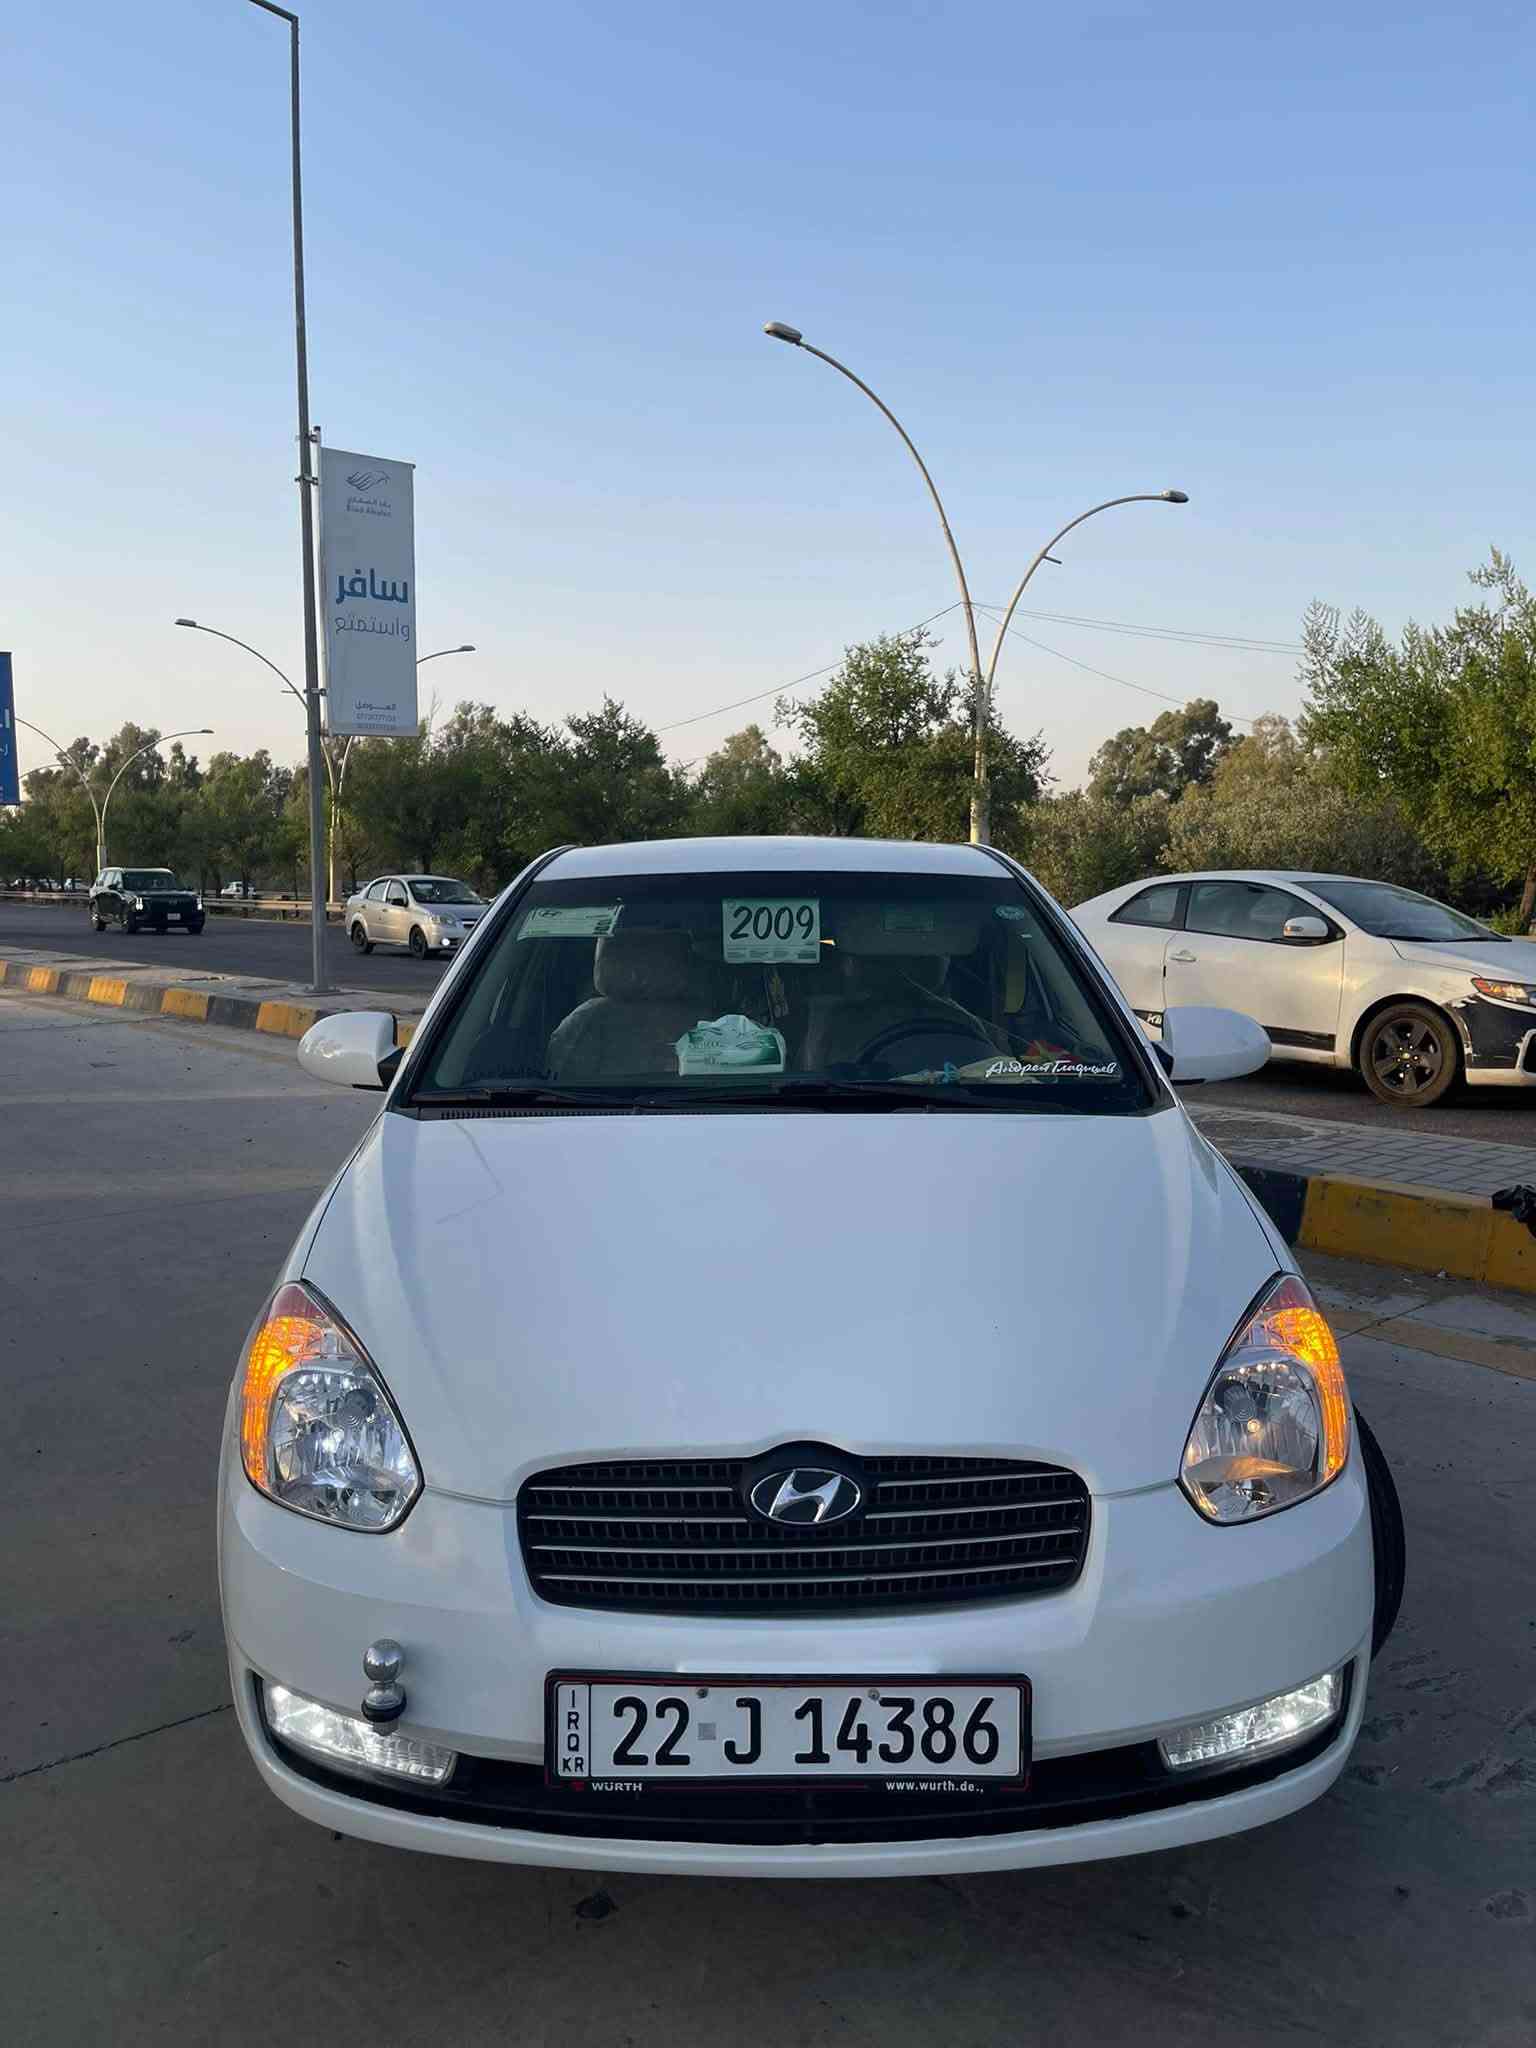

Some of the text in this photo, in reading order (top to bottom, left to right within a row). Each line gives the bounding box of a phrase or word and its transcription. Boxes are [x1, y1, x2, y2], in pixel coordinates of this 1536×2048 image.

[335, 567, 408, 604] سافر
[335, 610, 410, 641] واستمتع
[729, 905, 814, 940] 2009
[612, 1696, 999, 1766] 22 J 14386
[562, 1757, 584, 1773] KR
[591, 1782, 643, 1792] WÜRTH
